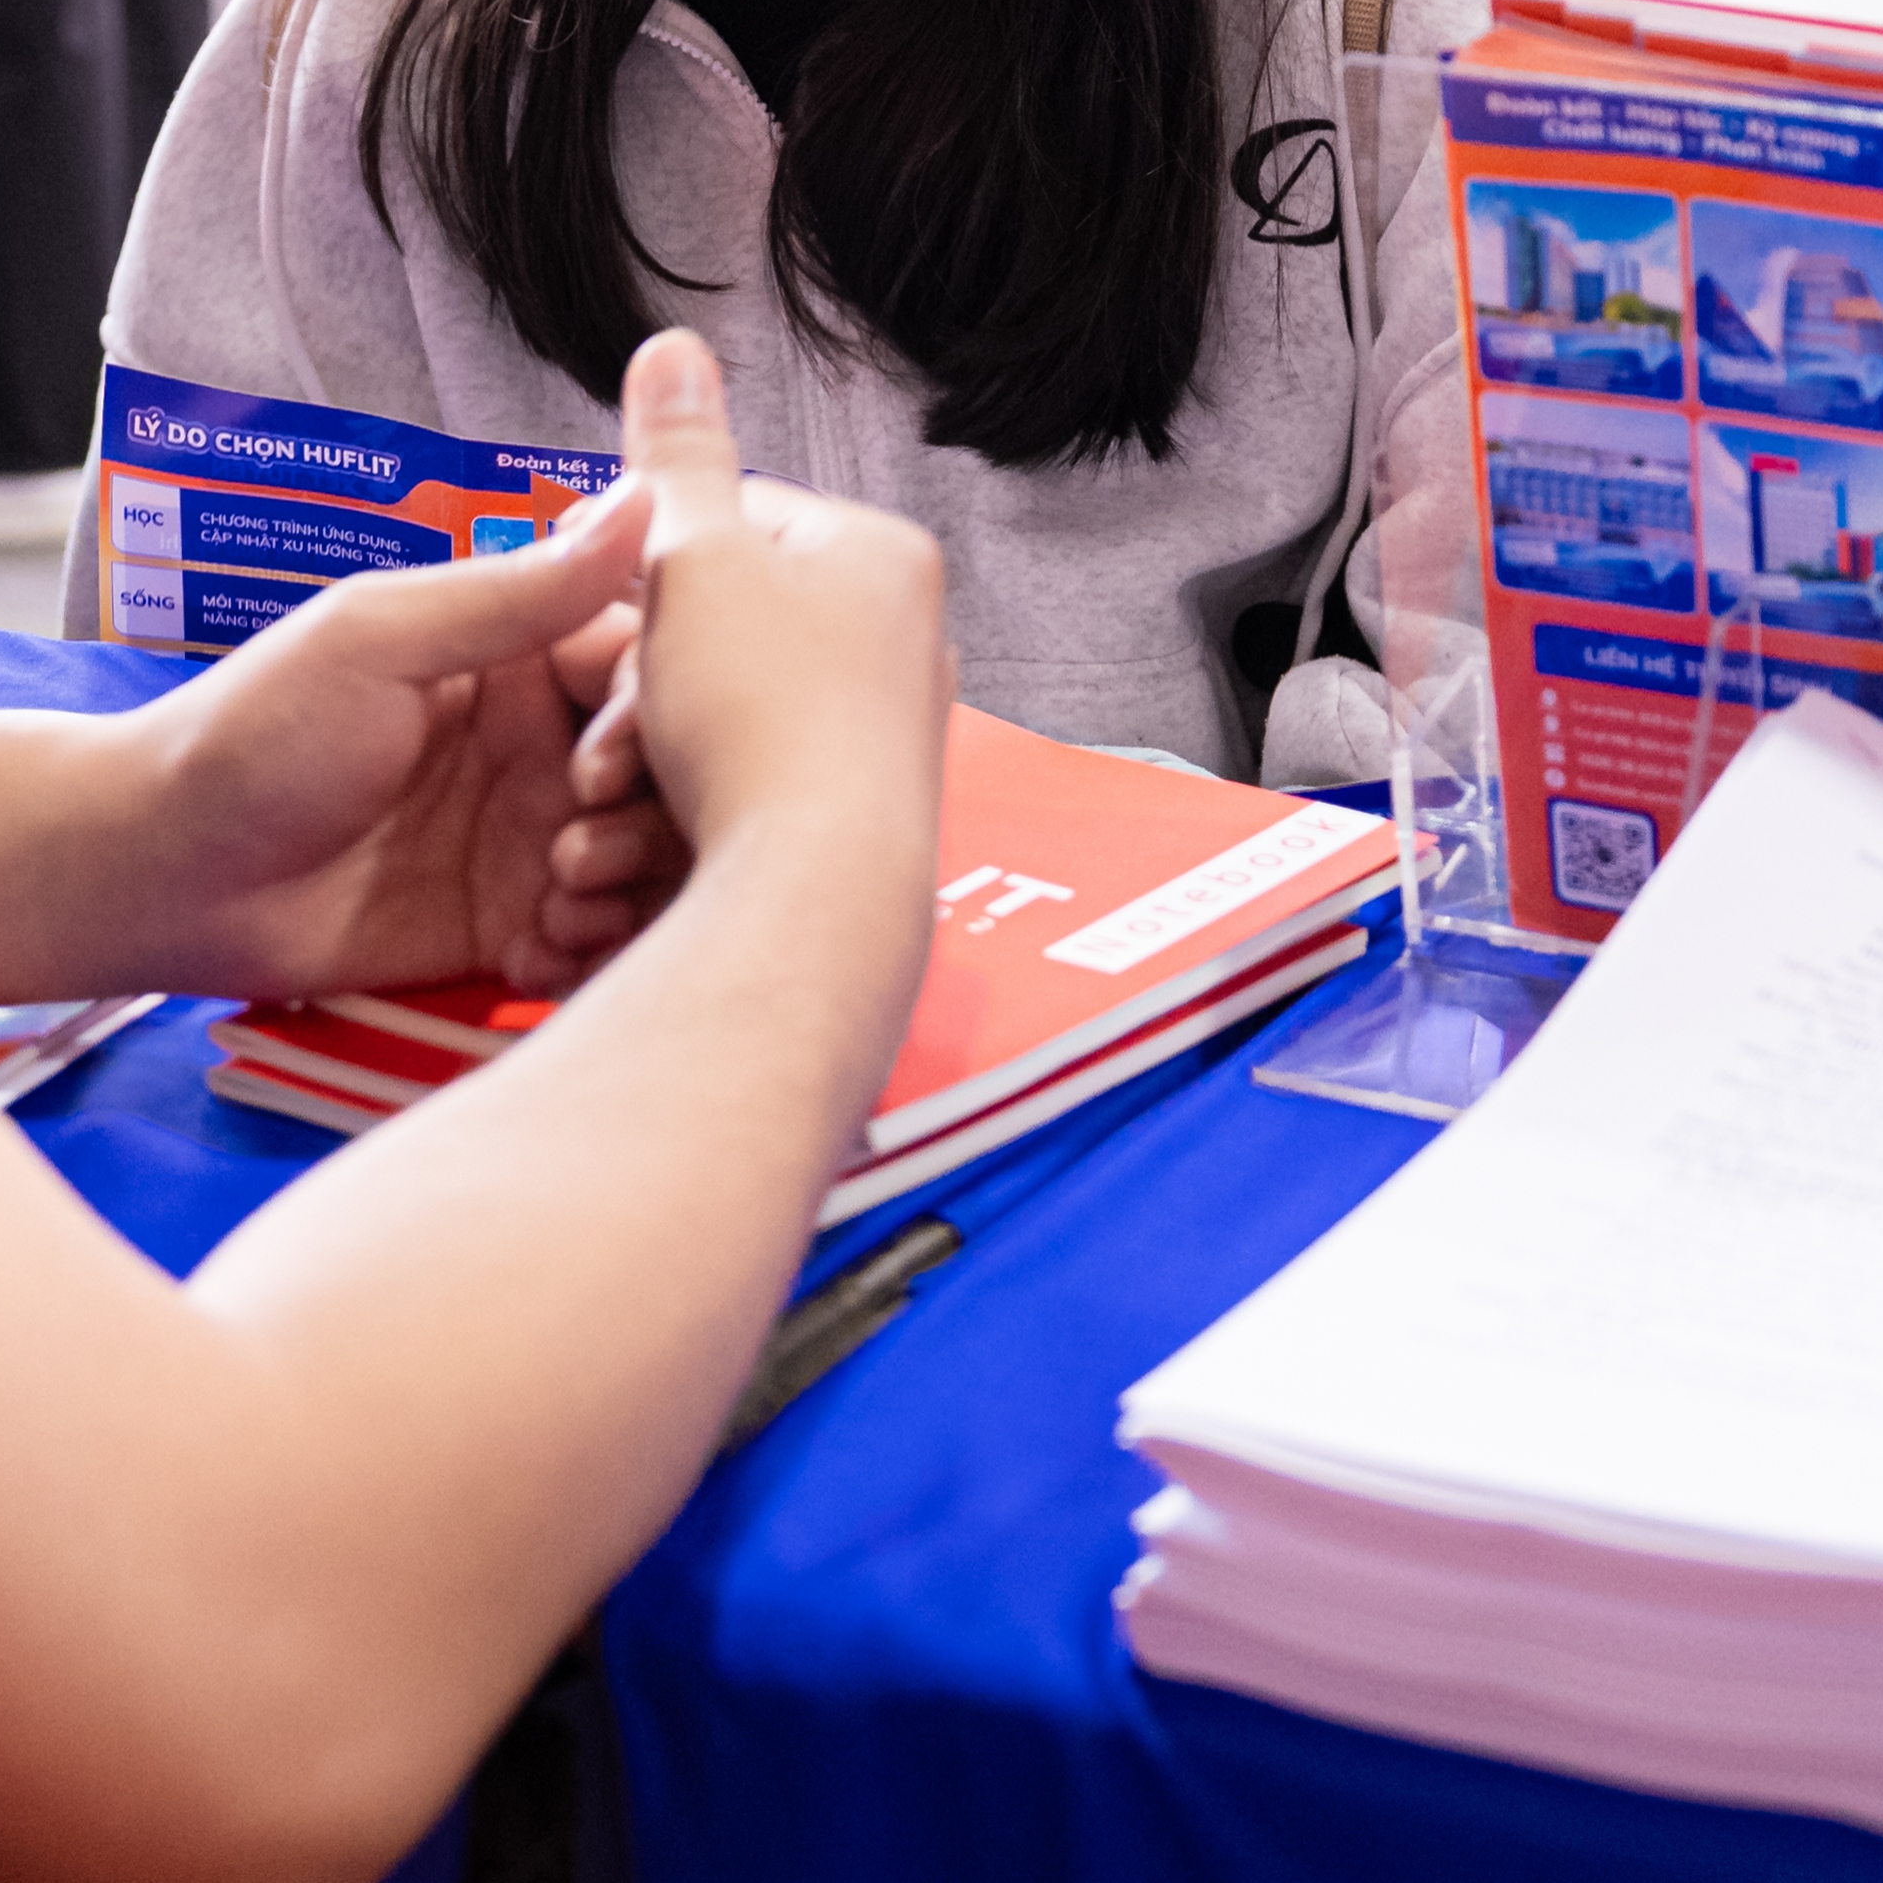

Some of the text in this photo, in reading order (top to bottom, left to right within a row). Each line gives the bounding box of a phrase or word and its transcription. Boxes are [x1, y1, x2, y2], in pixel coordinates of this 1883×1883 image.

[134, 413, 396, 477] LÝ DO CHỌN HUFLIT
[496, 453, 552, 470] Đoàn
[558, 458, 590, 474] kết
[124, 505, 164, 528] HỌC
[200, 511, 268, 531] CHƯƠNG
[271, 518, 318, 537] TRÌNH
[322, 525, 356, 543] ỨNG
[359, 533, 402, 553] DỤNG
[200, 528, 232, 546] CẬP
[236, 532, 279, 551] NHẬT
[283, 539, 304, 553] XU
[307, 543, 363, 561] HƯỚNG
[120, 588, 176, 610] SỐNG
[202, 593, 232, 609] MÔI
[203, 610, 248, 628] NĂNG
[1074, 816, 1354, 960] Notebook
